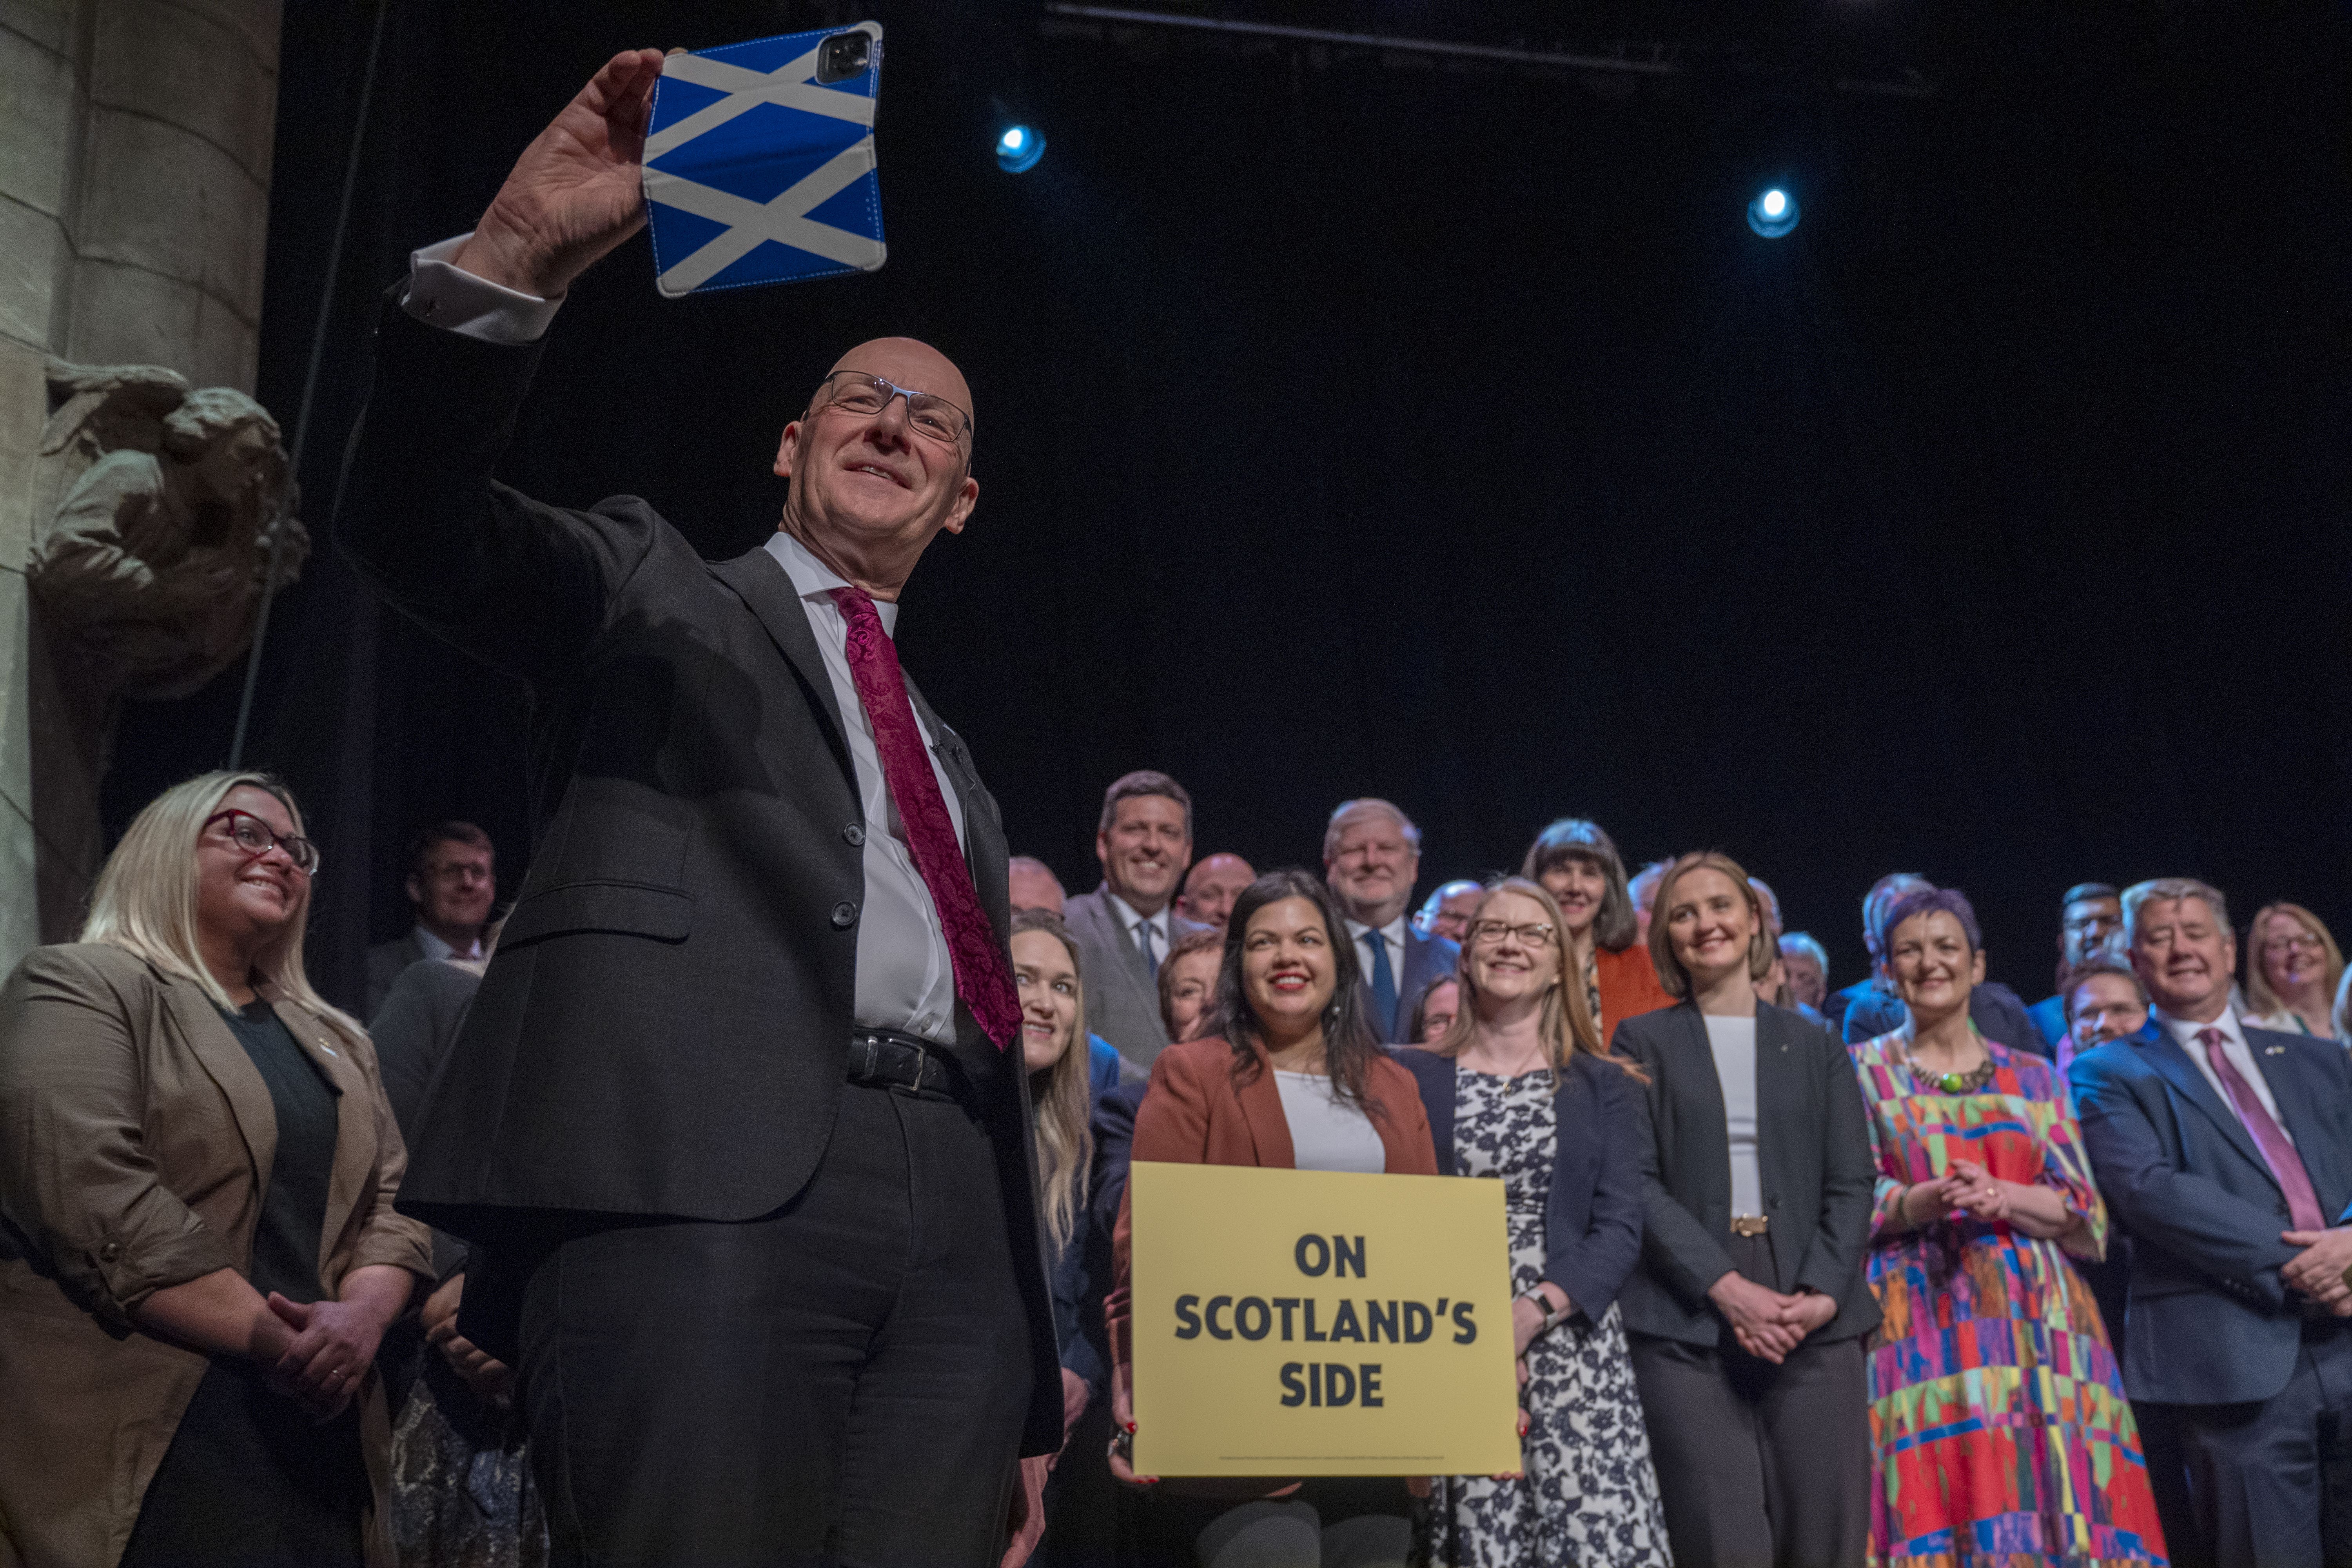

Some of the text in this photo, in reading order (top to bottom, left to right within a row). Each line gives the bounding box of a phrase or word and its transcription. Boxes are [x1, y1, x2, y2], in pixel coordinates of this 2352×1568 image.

[1294, 1233, 1367, 1279] ON
[1174, 1294, 1477, 1345] SCOTLAND'S
[1279, 1361, 1384, 1408] SIDE
